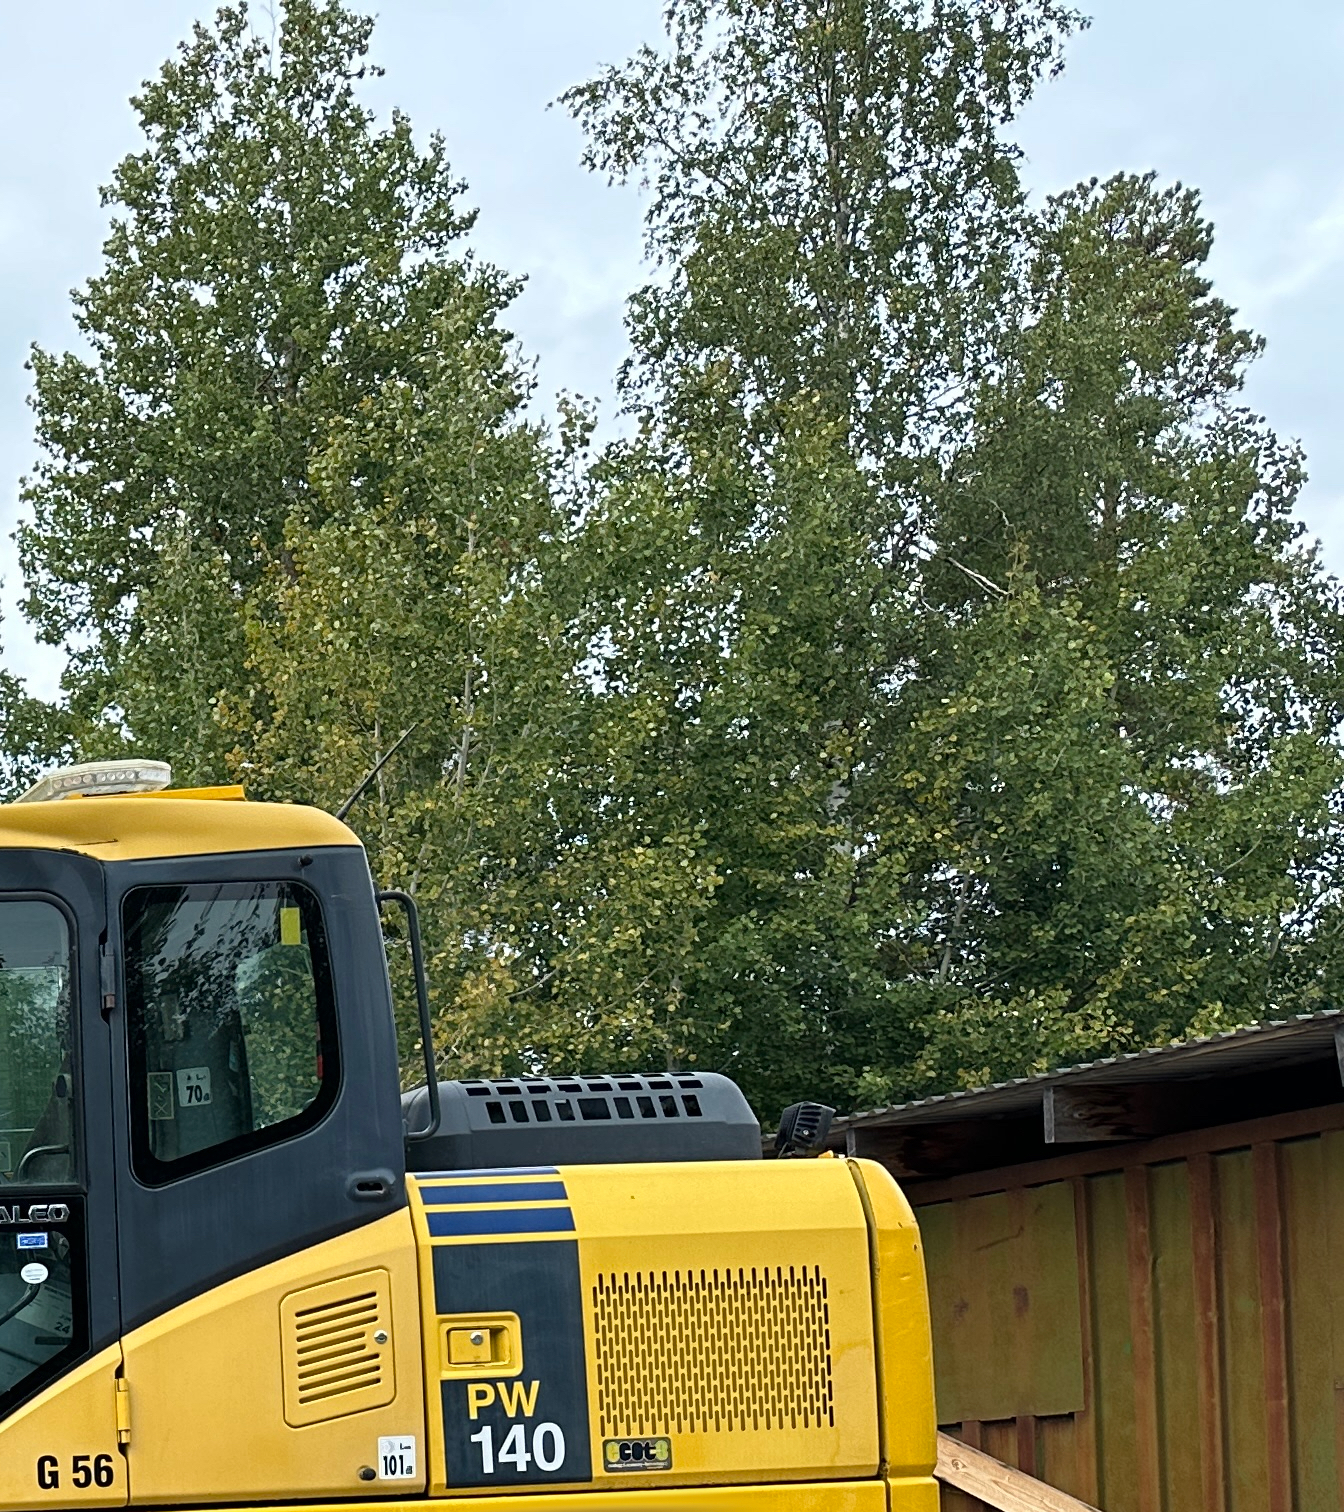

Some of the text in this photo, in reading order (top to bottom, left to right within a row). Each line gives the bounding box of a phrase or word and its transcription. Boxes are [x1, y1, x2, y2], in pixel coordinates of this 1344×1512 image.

[467, 1380, 540, 1420] PW
[383, 1454, 404, 1476] 101
[470, 1422, 566, 1474] 140
[37, 1453, 114, 1490] G 56
